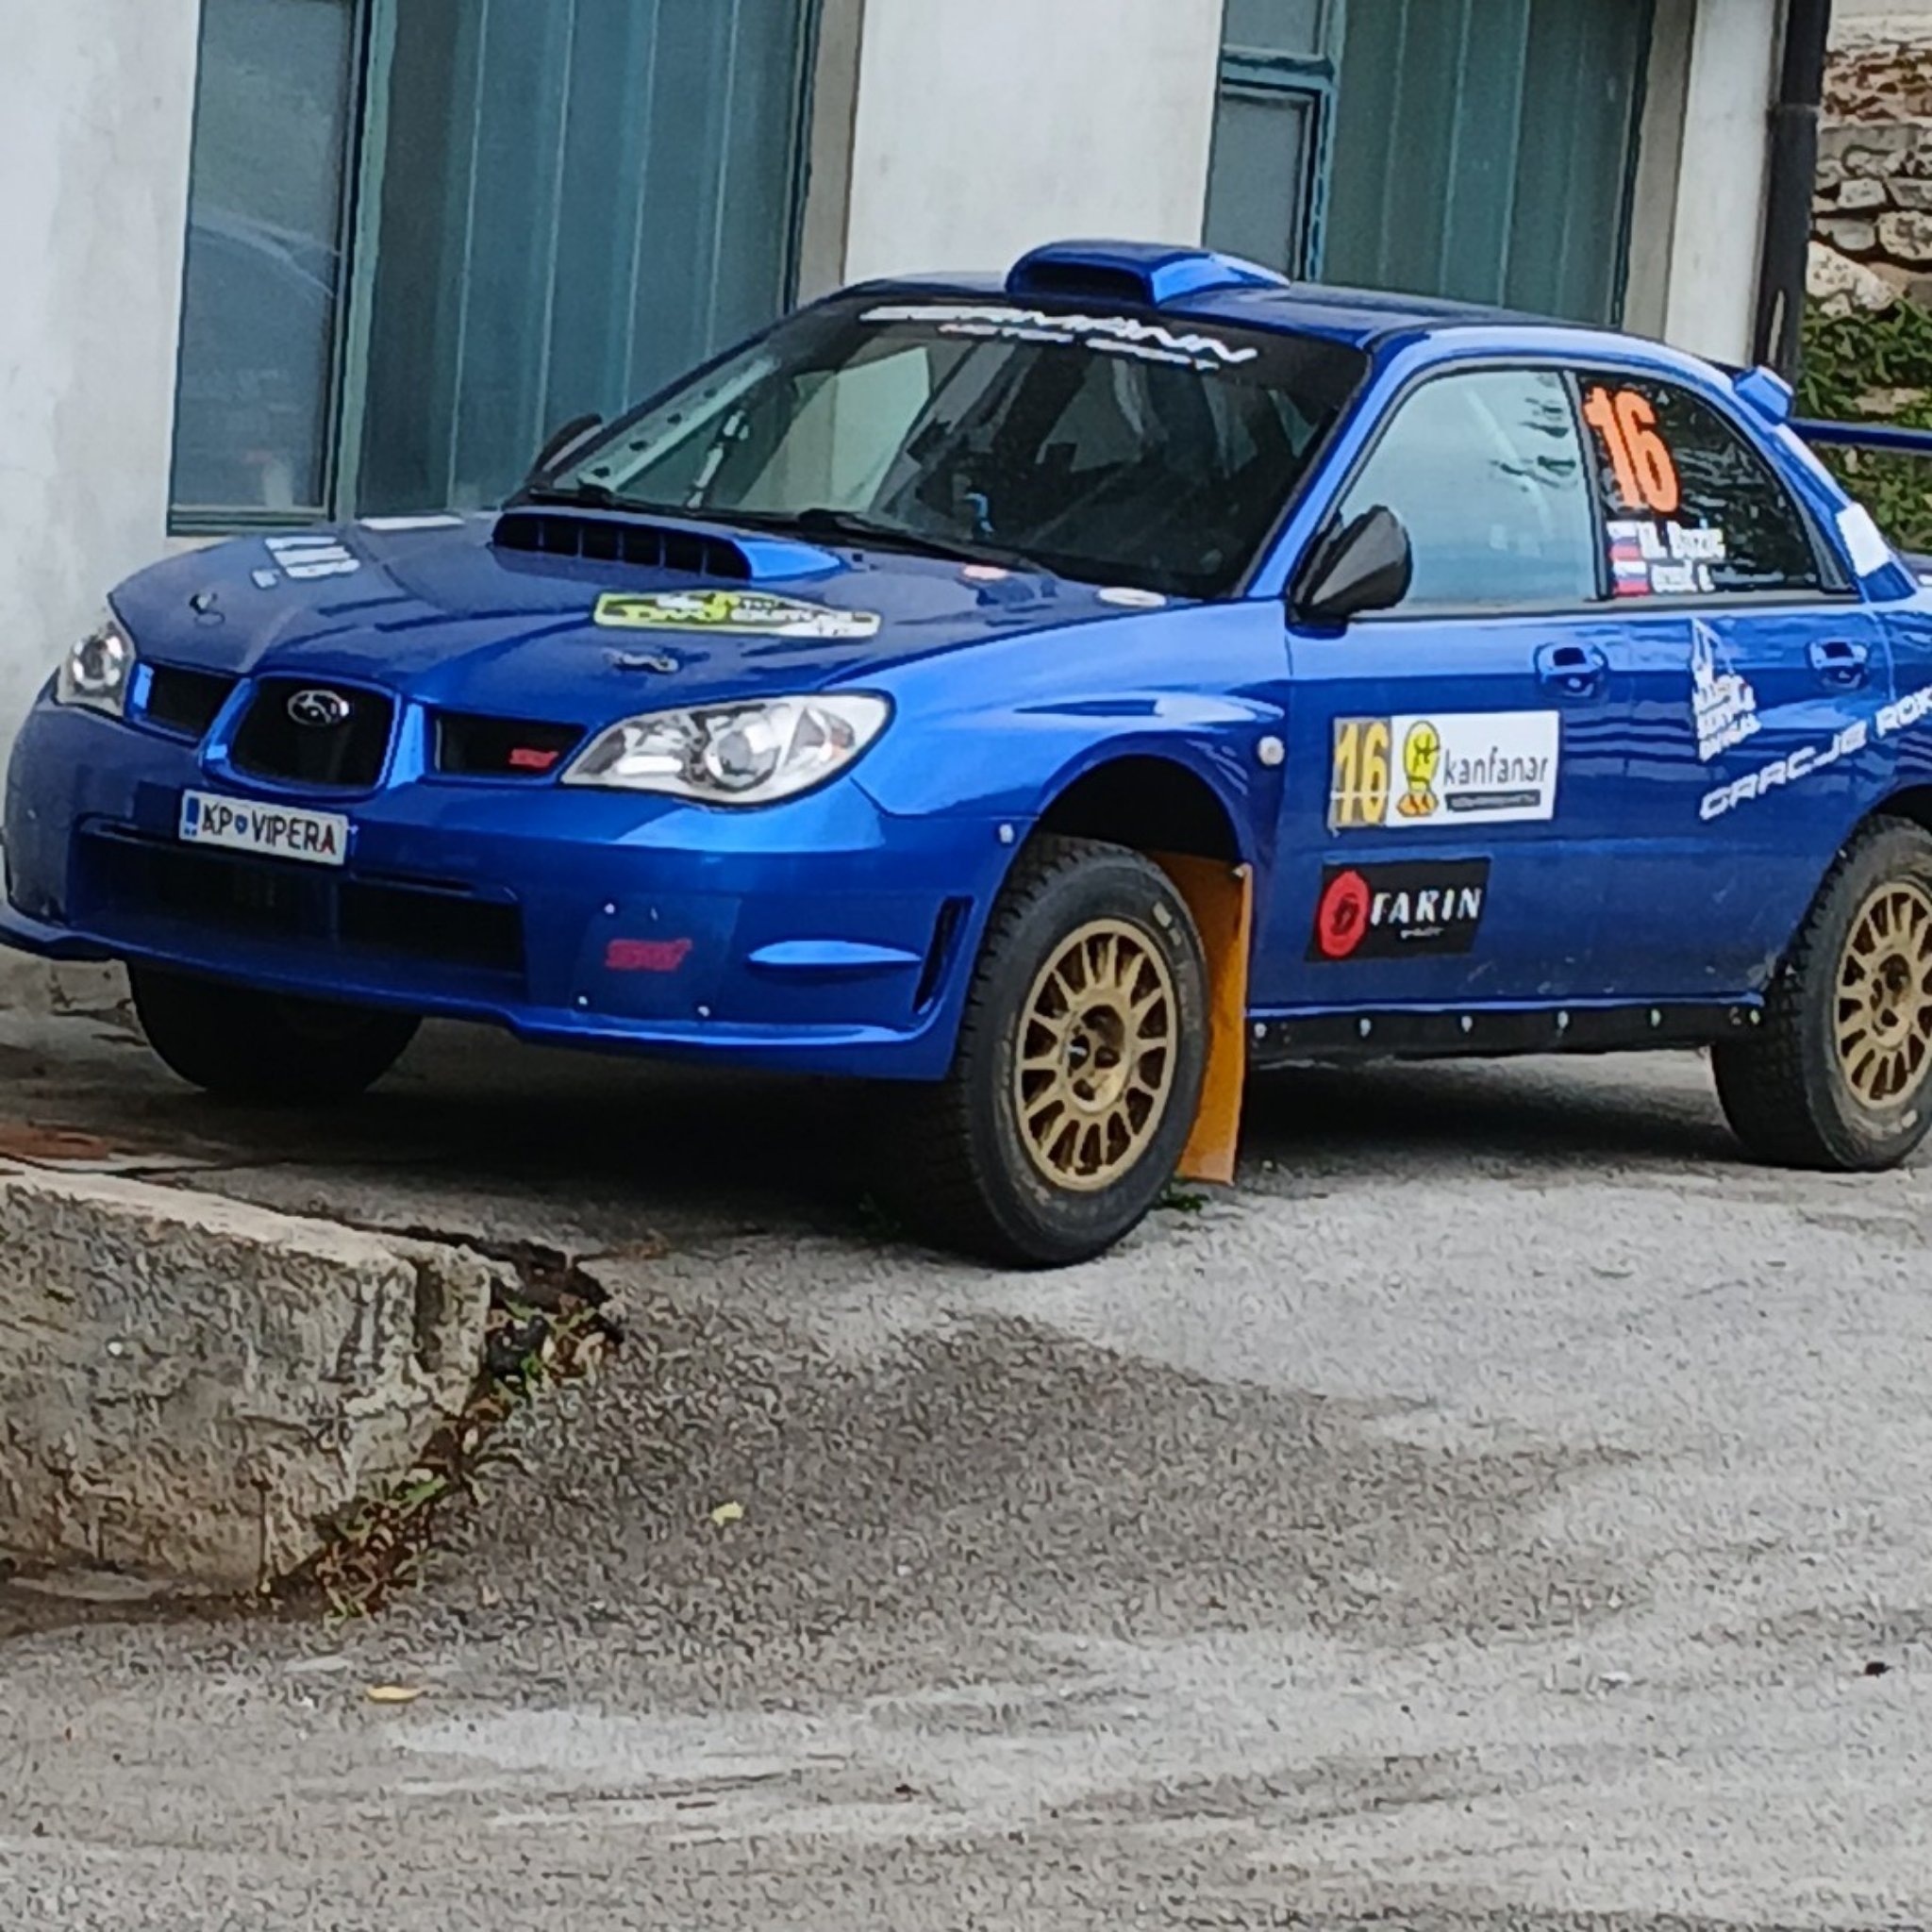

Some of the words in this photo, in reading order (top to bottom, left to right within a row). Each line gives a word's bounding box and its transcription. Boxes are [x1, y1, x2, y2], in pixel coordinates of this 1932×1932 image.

[1584, 385, 1679, 513] 16
[1334, 721, 1390, 825] 16
[1442, 745, 1549, 787] kanfanar
[251, 808, 338, 856] VIPERA
